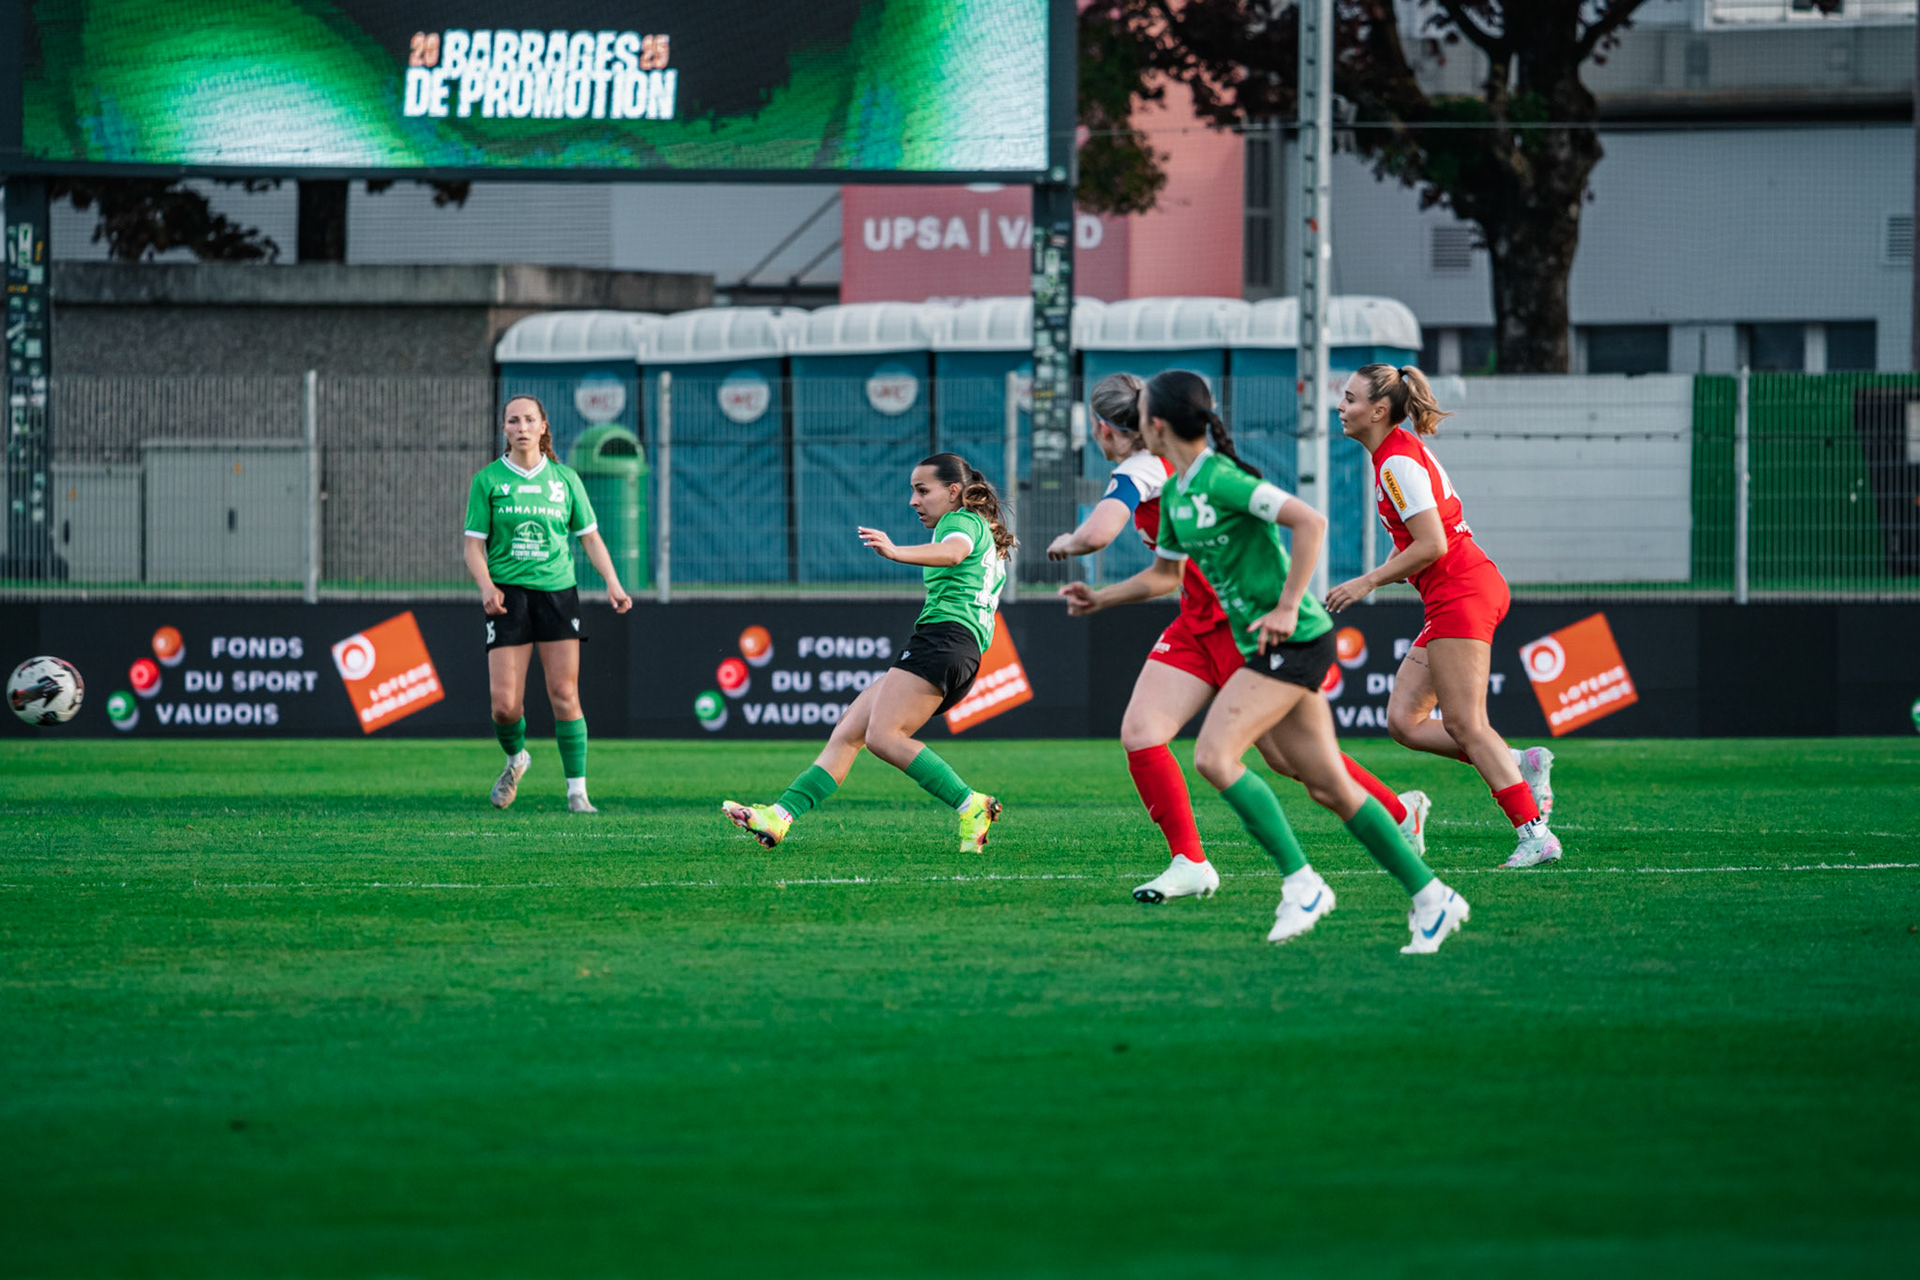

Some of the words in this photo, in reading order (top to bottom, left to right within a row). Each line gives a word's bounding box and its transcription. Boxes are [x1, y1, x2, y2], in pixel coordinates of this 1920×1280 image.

[409, 31, 440, 68] 20
[442, 29, 642, 75] BARRAGES
[639, 33, 670, 70] 25
[404, 66, 450, 117] DE
[456, 69, 678, 120] PROMOTION
[862, 215, 972, 251] UPSA
[997, 215, 1104, 250] VD
[210, 636, 305, 659] FONDS
[797, 635, 893, 659] FONDS
[184, 670, 224, 692] DU
[231, 670, 318, 692] SPORT
[771, 669, 812, 692] DU
[818, 669, 888, 692] SPO
[155, 703, 280, 725] VAUDOIS
[742, 702, 850, 725] VAUDO
